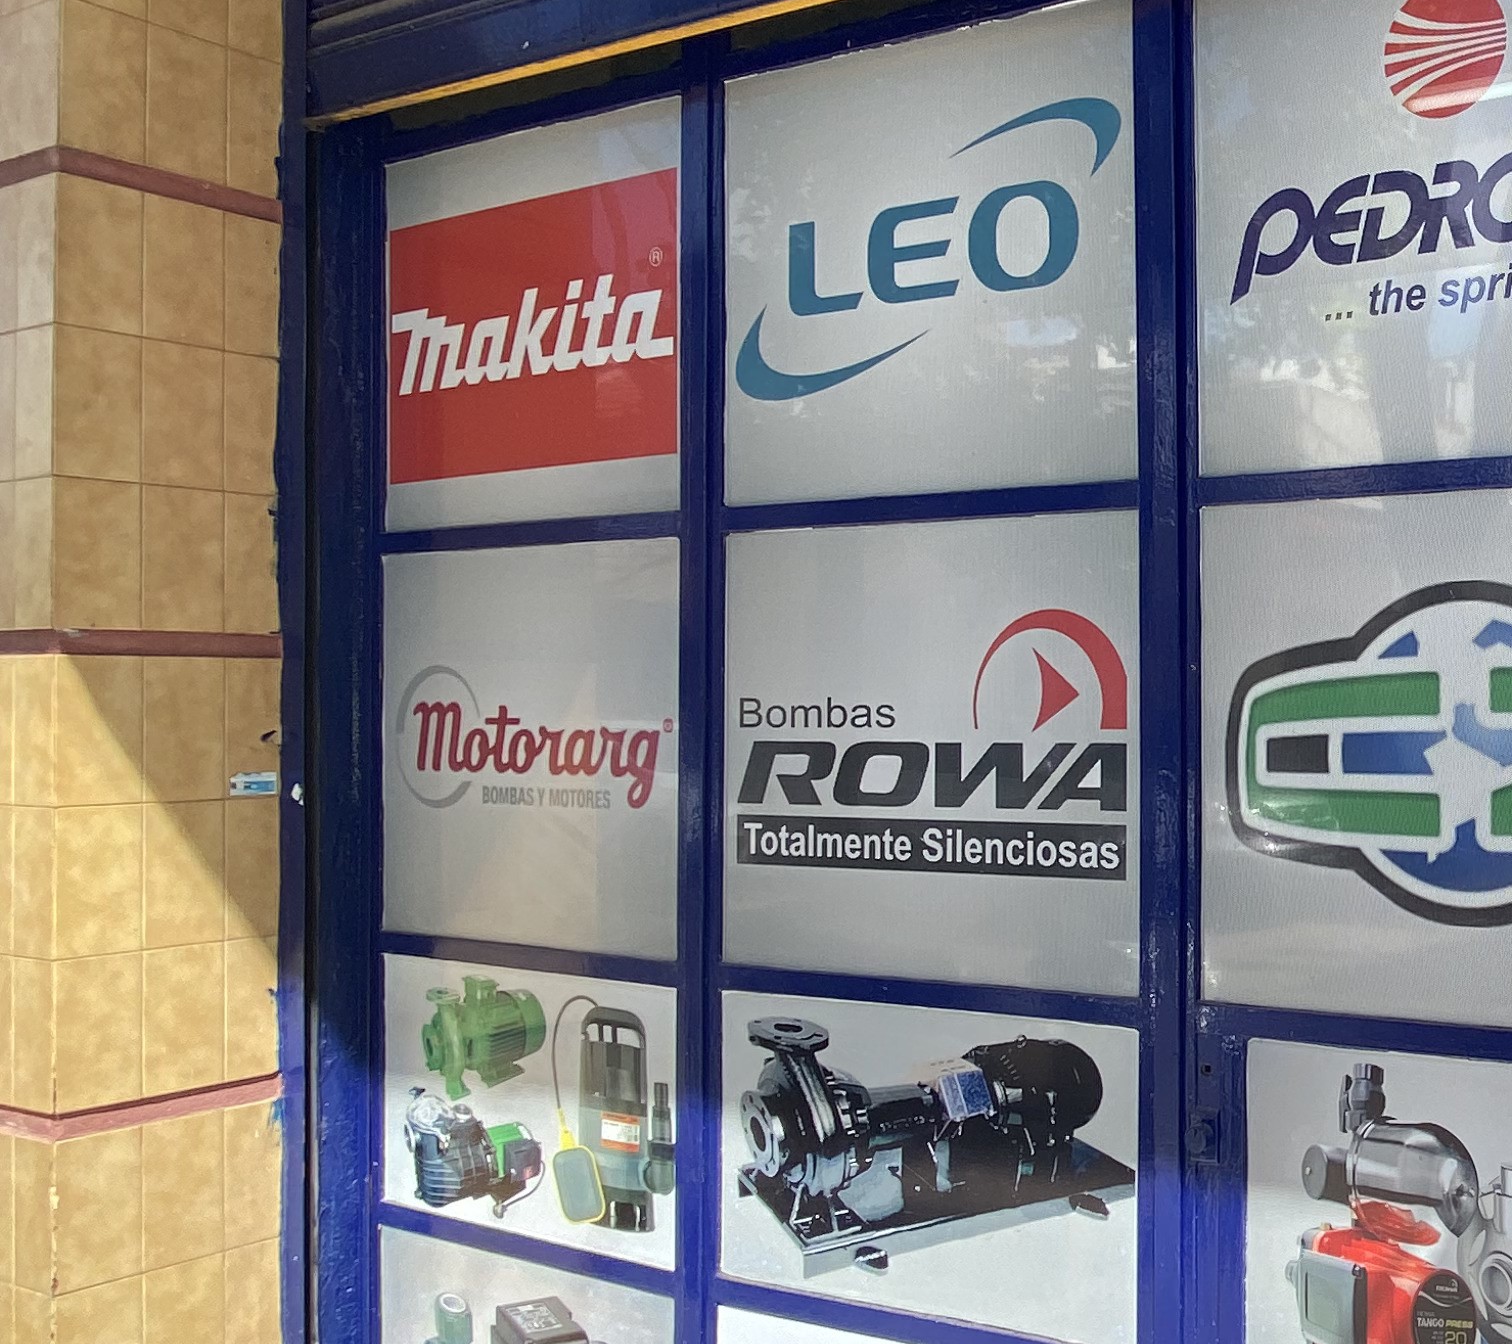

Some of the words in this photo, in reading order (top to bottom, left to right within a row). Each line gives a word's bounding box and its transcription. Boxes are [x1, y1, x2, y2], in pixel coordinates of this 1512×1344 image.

[788, 179, 1080, 317] LEO
[1368, 277, 1426, 317] the
[739, 697, 896, 729] Bombas
[413, 700, 660, 809] Motorarg
[737, 741, 1128, 812] ROWA
[482, 785, 534, 806] BOMBAS
[537, 787, 546, 806] Y
[550, 787, 611, 809] MOTORES
[743, 822, 912, 861] Totalmente
[921, 827, 1120, 870] Silenciosas
[1416, 1317, 1444, 1328] TANGO
